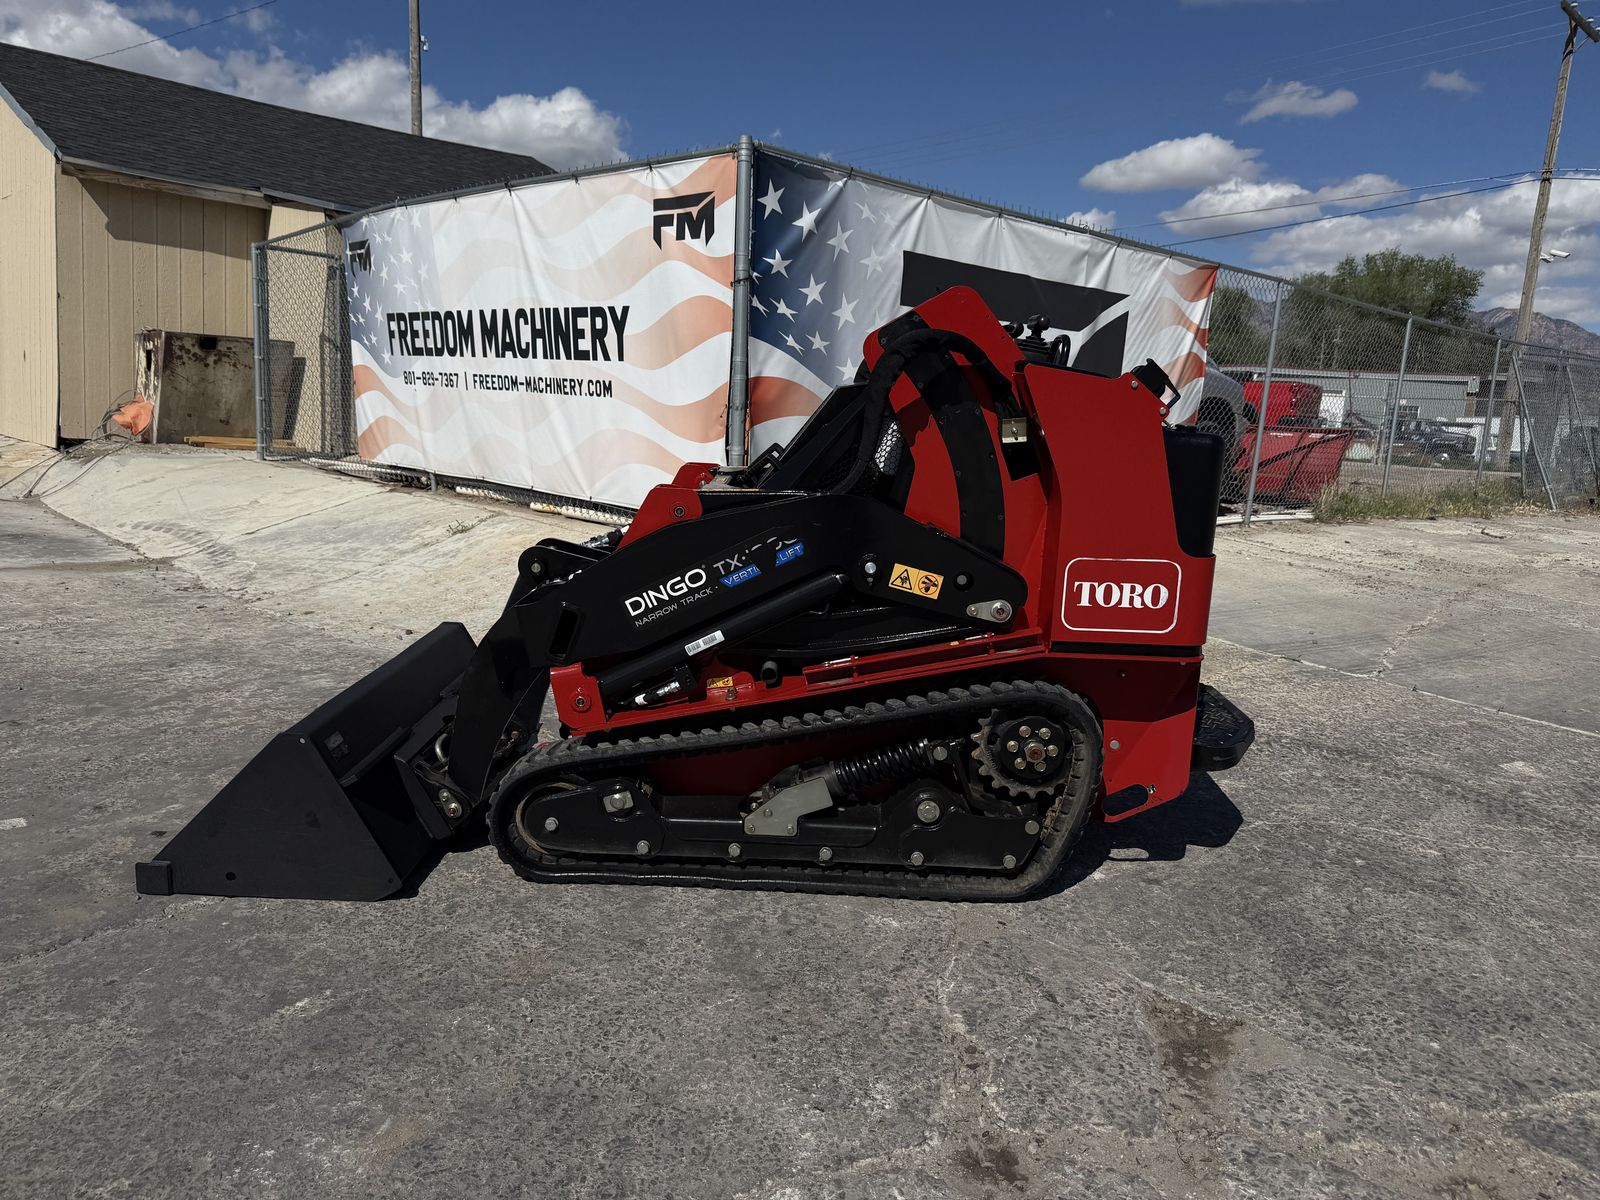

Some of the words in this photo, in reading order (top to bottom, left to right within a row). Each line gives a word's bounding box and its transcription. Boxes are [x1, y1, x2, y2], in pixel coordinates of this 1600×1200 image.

[652, 191, 716, 251] FM
[349, 239, 372, 278] FM
[386, 309, 476, 358] FREEDOM
[479, 305, 630, 362] MACHINERY
[403, 370, 459, 389] 801-829-7367
[472, 373, 613, 398] FREEDOM-MACHINERY.COM
[625, 568, 707, 617] DINGO
[634, 603, 678, 627] NARROW
[680, 586, 713, 606] TRACK
[1073, 581, 1169, 609] TORO
